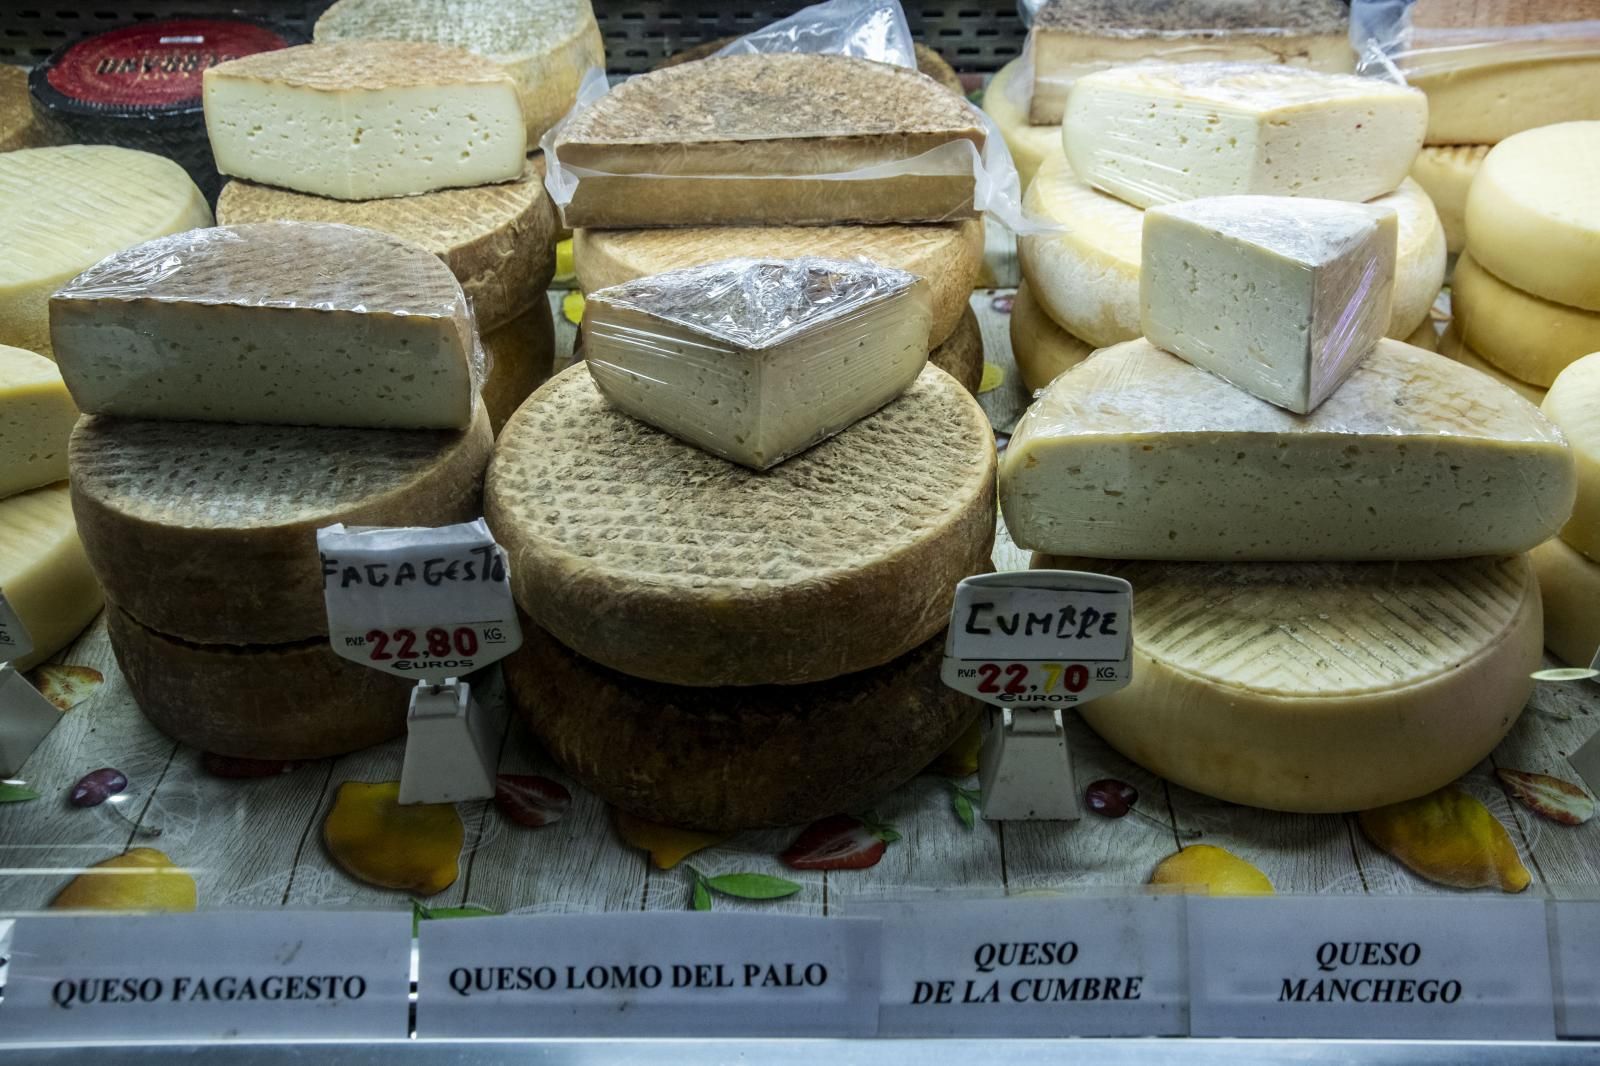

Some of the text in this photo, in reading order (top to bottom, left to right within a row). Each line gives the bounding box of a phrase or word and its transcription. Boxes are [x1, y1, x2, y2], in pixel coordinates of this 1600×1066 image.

[366, 627, 479, 660] 22,80
[977, 663, 1089, 694] 22,70
[973, 941, 1079, 972] QUESO
[1316, 942, 1421, 971] QUESO
[52, 974, 367, 1009] QUESO FAGAGESTO
[448, 962, 828, 996] QUESO LOMO DEL PALO
[911, 976, 1143, 1005] DE LA CUMBRE
[1278, 978, 1463, 1005] MANCHEGO
